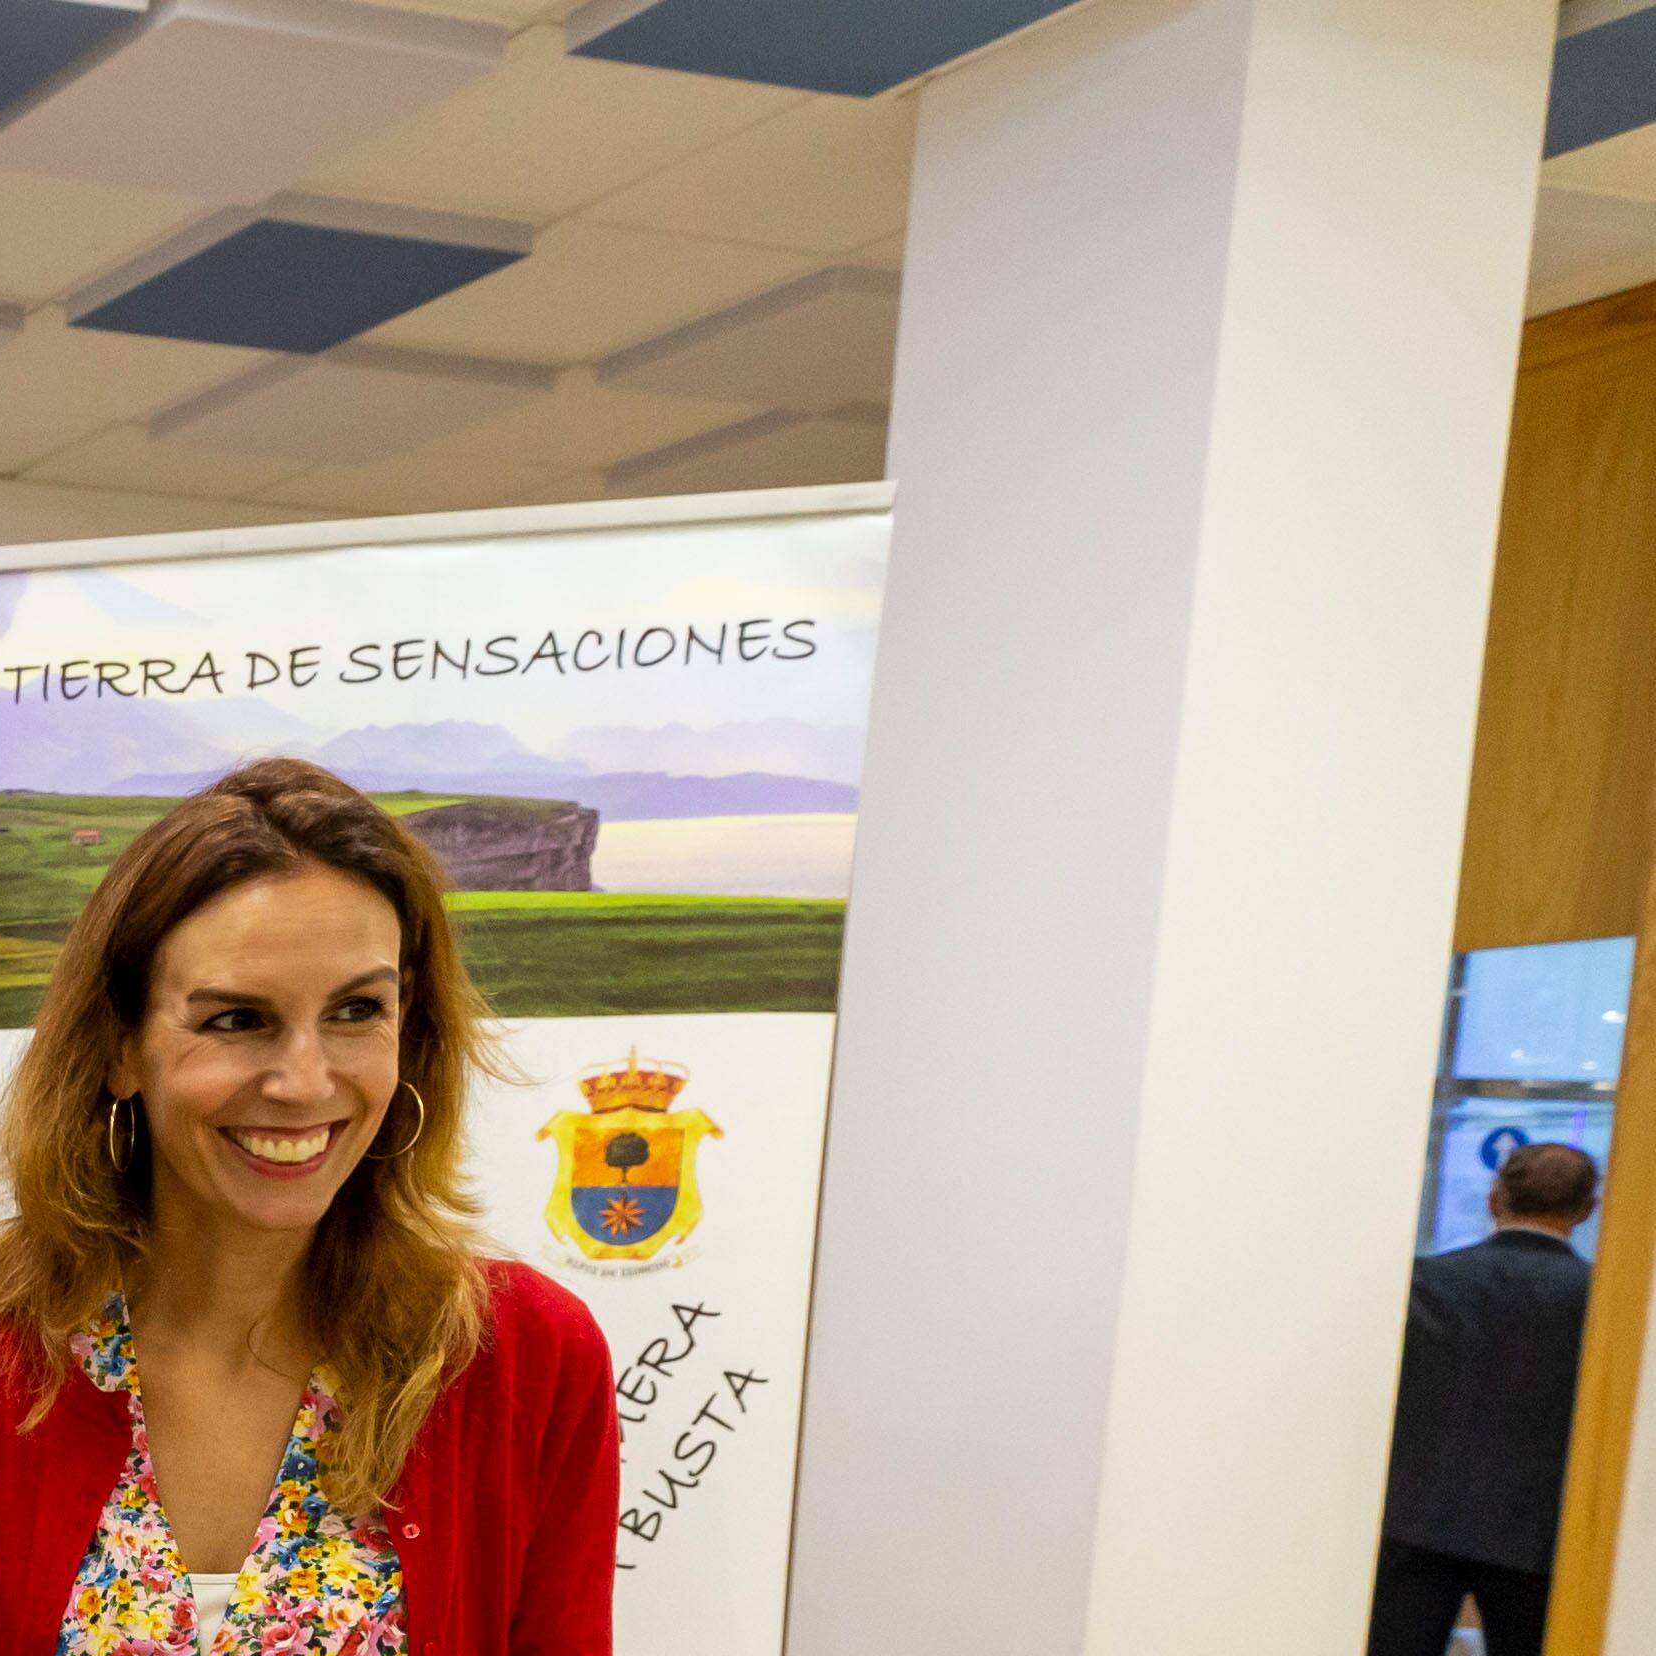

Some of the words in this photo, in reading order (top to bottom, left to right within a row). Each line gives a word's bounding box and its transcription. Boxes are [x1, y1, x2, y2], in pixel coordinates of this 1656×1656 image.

[4, 651, 225, 705] TIERRA
[247, 645, 321, 690] DE
[339, 618, 818, 685] SENSACIONES
[619, 1369, 769, 1542] BUSTA
